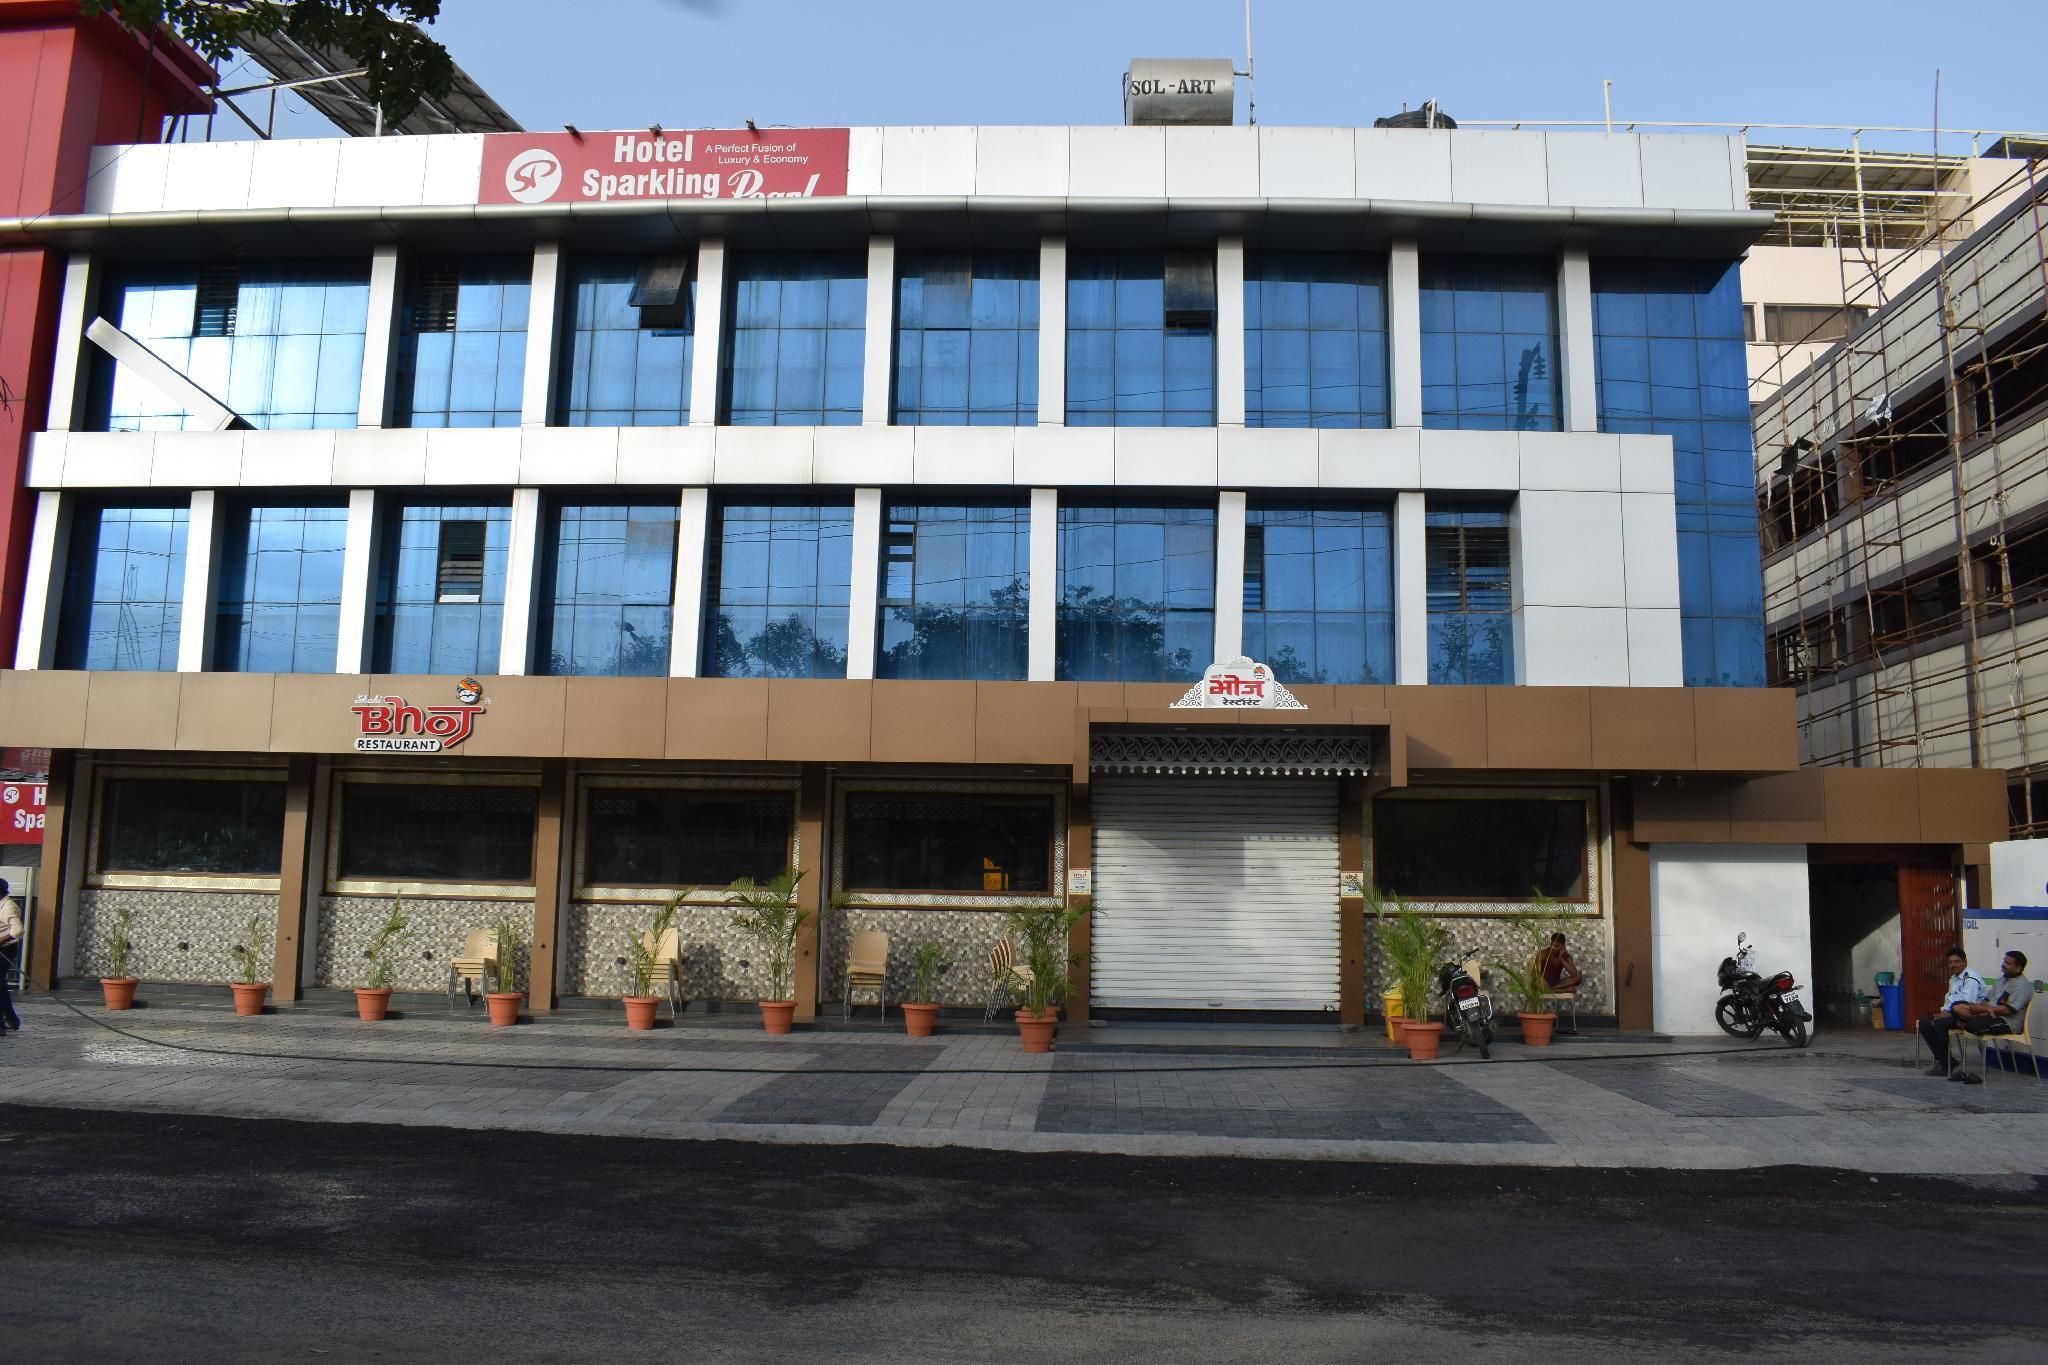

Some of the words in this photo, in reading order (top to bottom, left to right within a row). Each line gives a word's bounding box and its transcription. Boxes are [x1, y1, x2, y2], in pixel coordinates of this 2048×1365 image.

[614, 134, 694, 163] Hotel
[705, 144, 713, 153] A
[714, 144, 750, 153] Perfect
[751, 143, 784, 153] Fusion
[787, 142, 797, 152] of
[718, 155, 750, 166] Luxury
[753, 155, 760, 164] &
[763, 154, 809, 165] Economy
[582, 167, 720, 201] Sparkling
[357, 739, 436, 750] RESTAURANT
